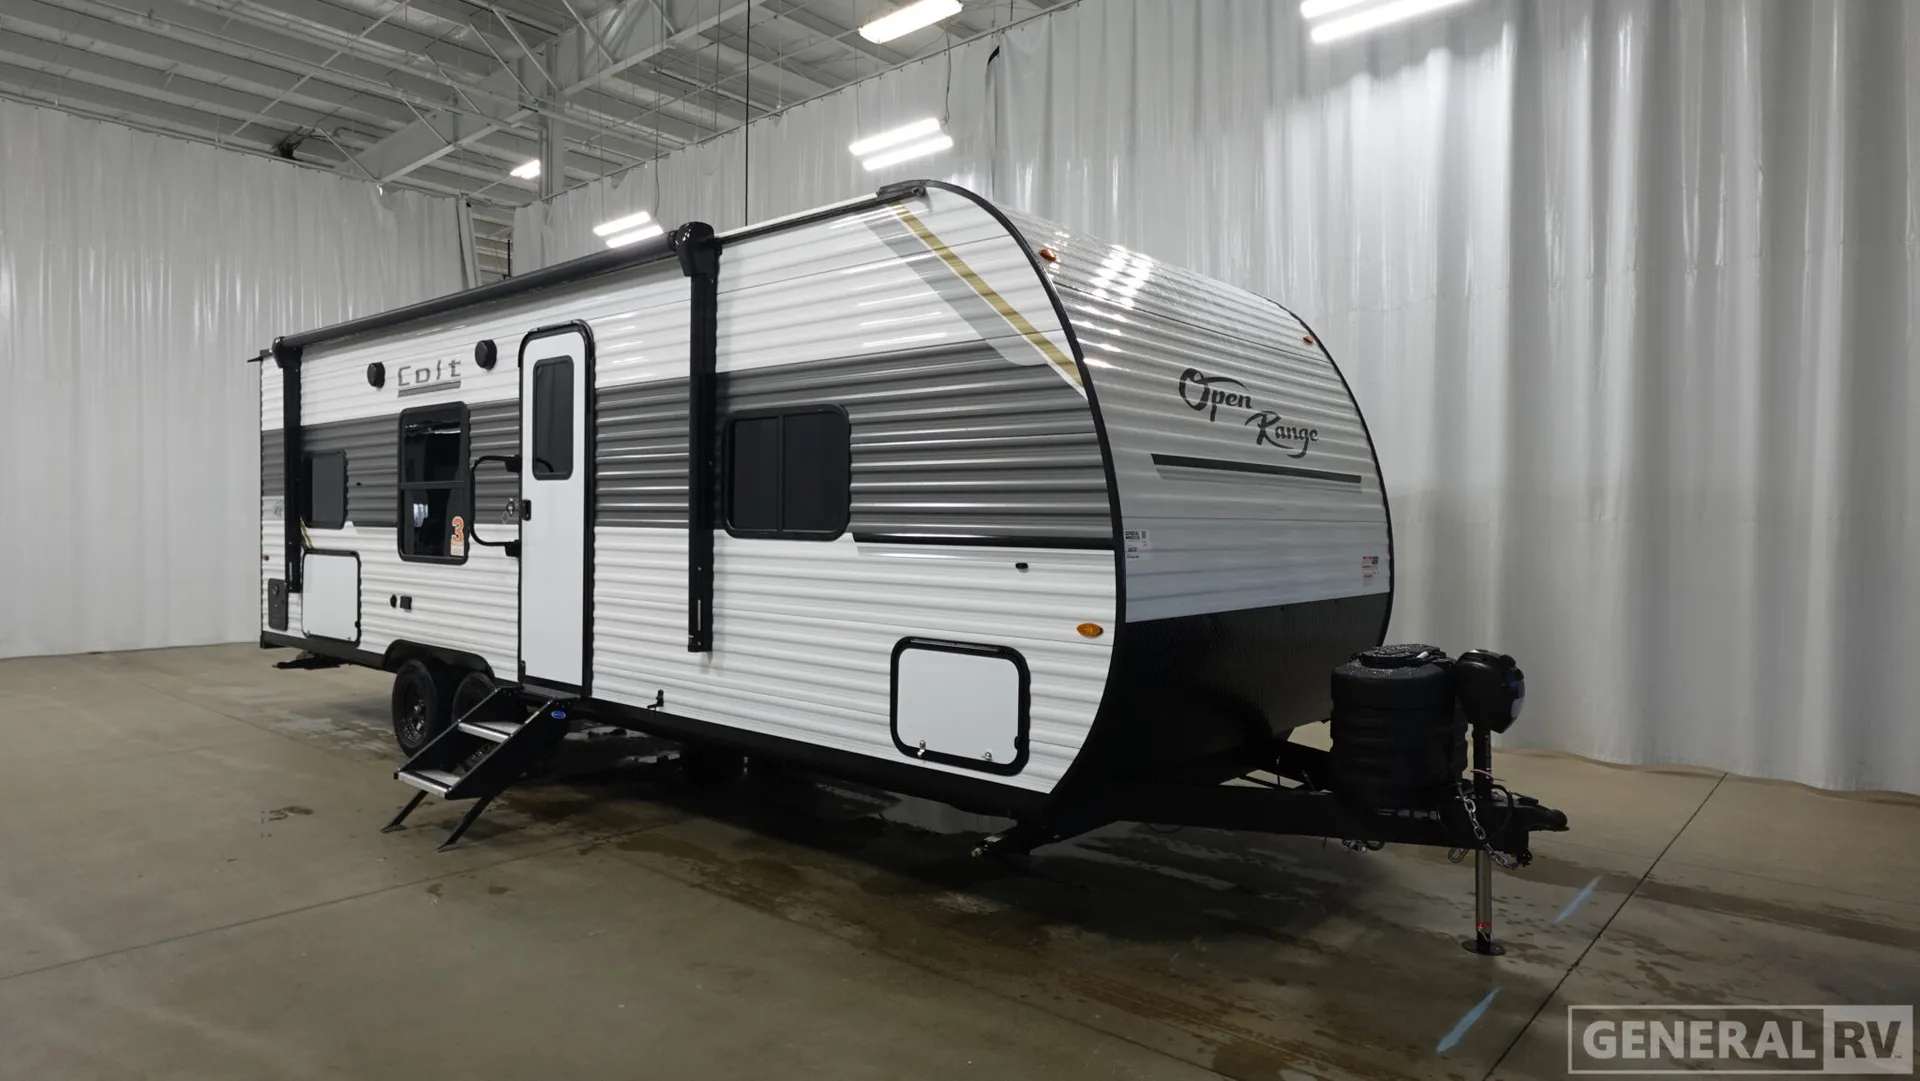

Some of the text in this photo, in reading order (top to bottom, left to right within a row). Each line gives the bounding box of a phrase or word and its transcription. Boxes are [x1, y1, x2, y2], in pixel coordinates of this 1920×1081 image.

[398, 359, 461, 386] Colt
[1179, 368, 1252, 422] Open
[1244, 410, 1319, 459] Range
[452, 516, 464, 541] 3
